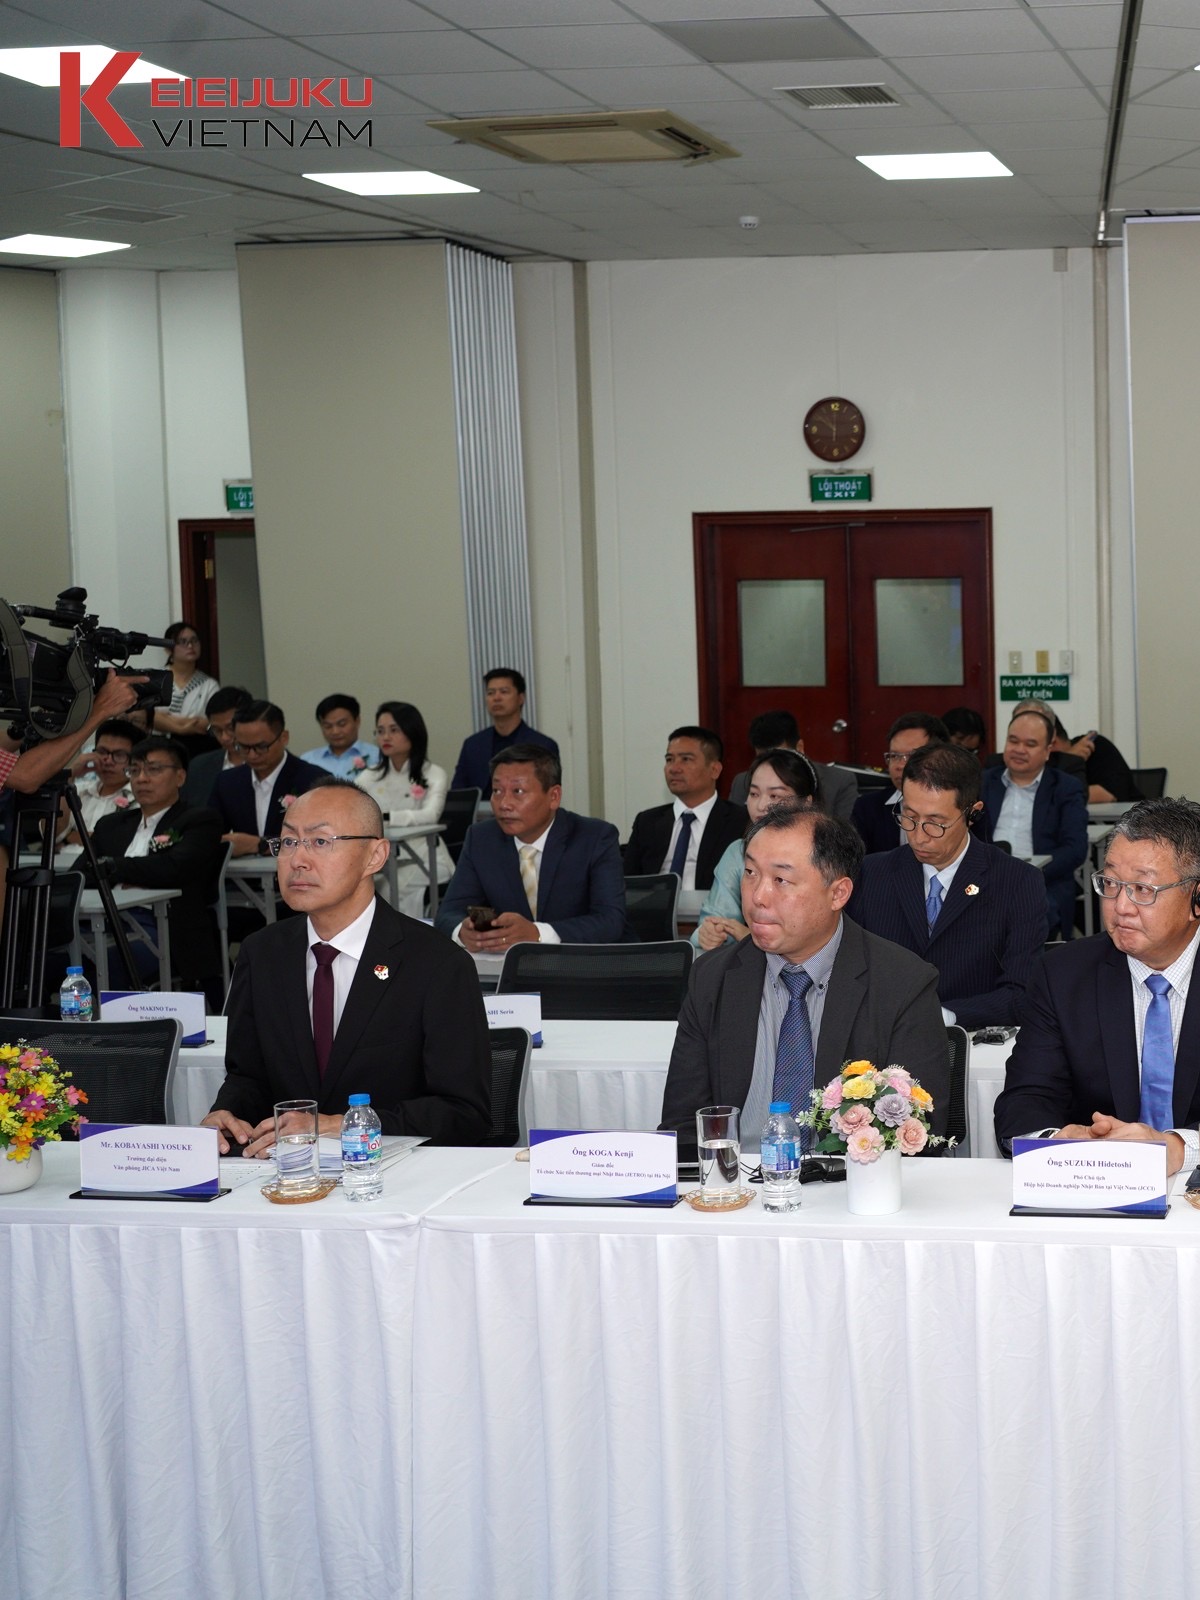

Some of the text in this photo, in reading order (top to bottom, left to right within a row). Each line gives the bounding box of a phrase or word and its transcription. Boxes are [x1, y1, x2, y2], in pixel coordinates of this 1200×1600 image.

[834, 479, 862, 490] THOÁT
[1001, 679, 1014, 687] RA
[101, 1141, 192, 1151] Mr. KOBAYASHI YOSUKE
[572, 1147, 634, 1158] Ông KOGA Kenji
[1047, 1157, 1063, 1167] Ông
[1097, 1160, 1132, 1168] Hidetoshi
